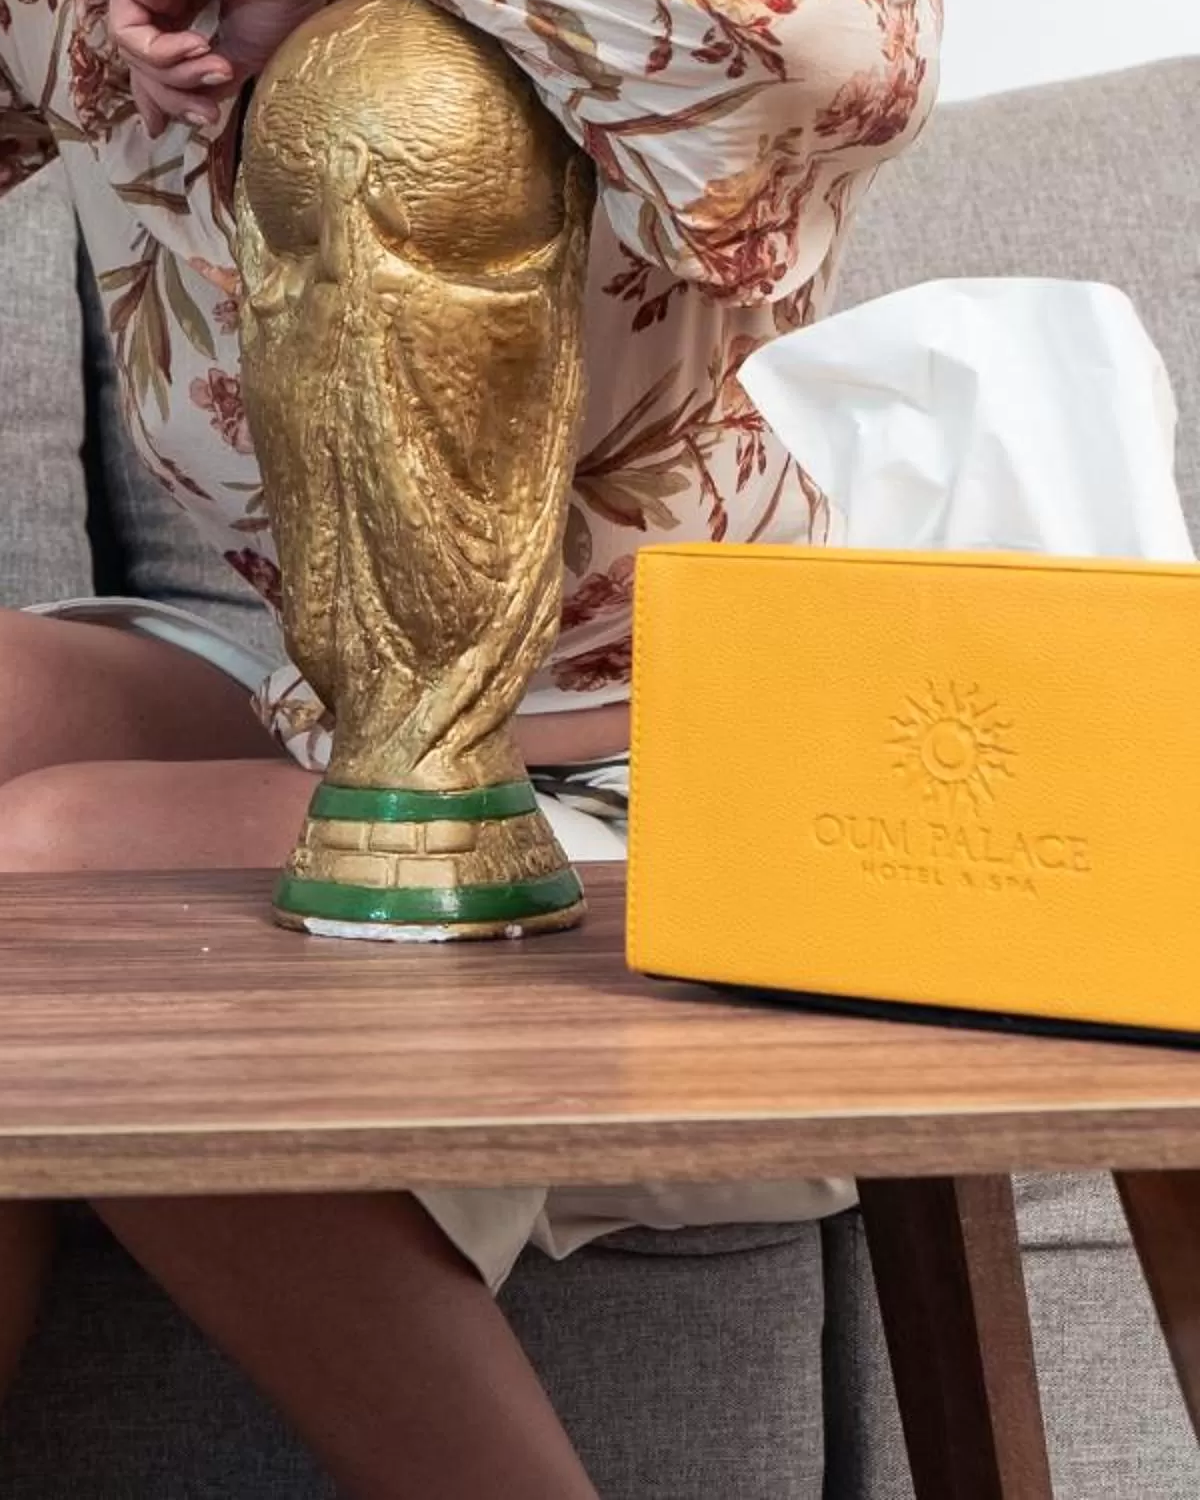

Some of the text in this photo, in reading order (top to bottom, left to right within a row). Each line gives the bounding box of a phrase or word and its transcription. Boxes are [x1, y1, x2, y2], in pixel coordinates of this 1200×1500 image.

[813, 812, 1093, 873] OUM PALACE
[859, 858, 946, 887] HOTEL
[986, 872, 1041, 899] SPA
